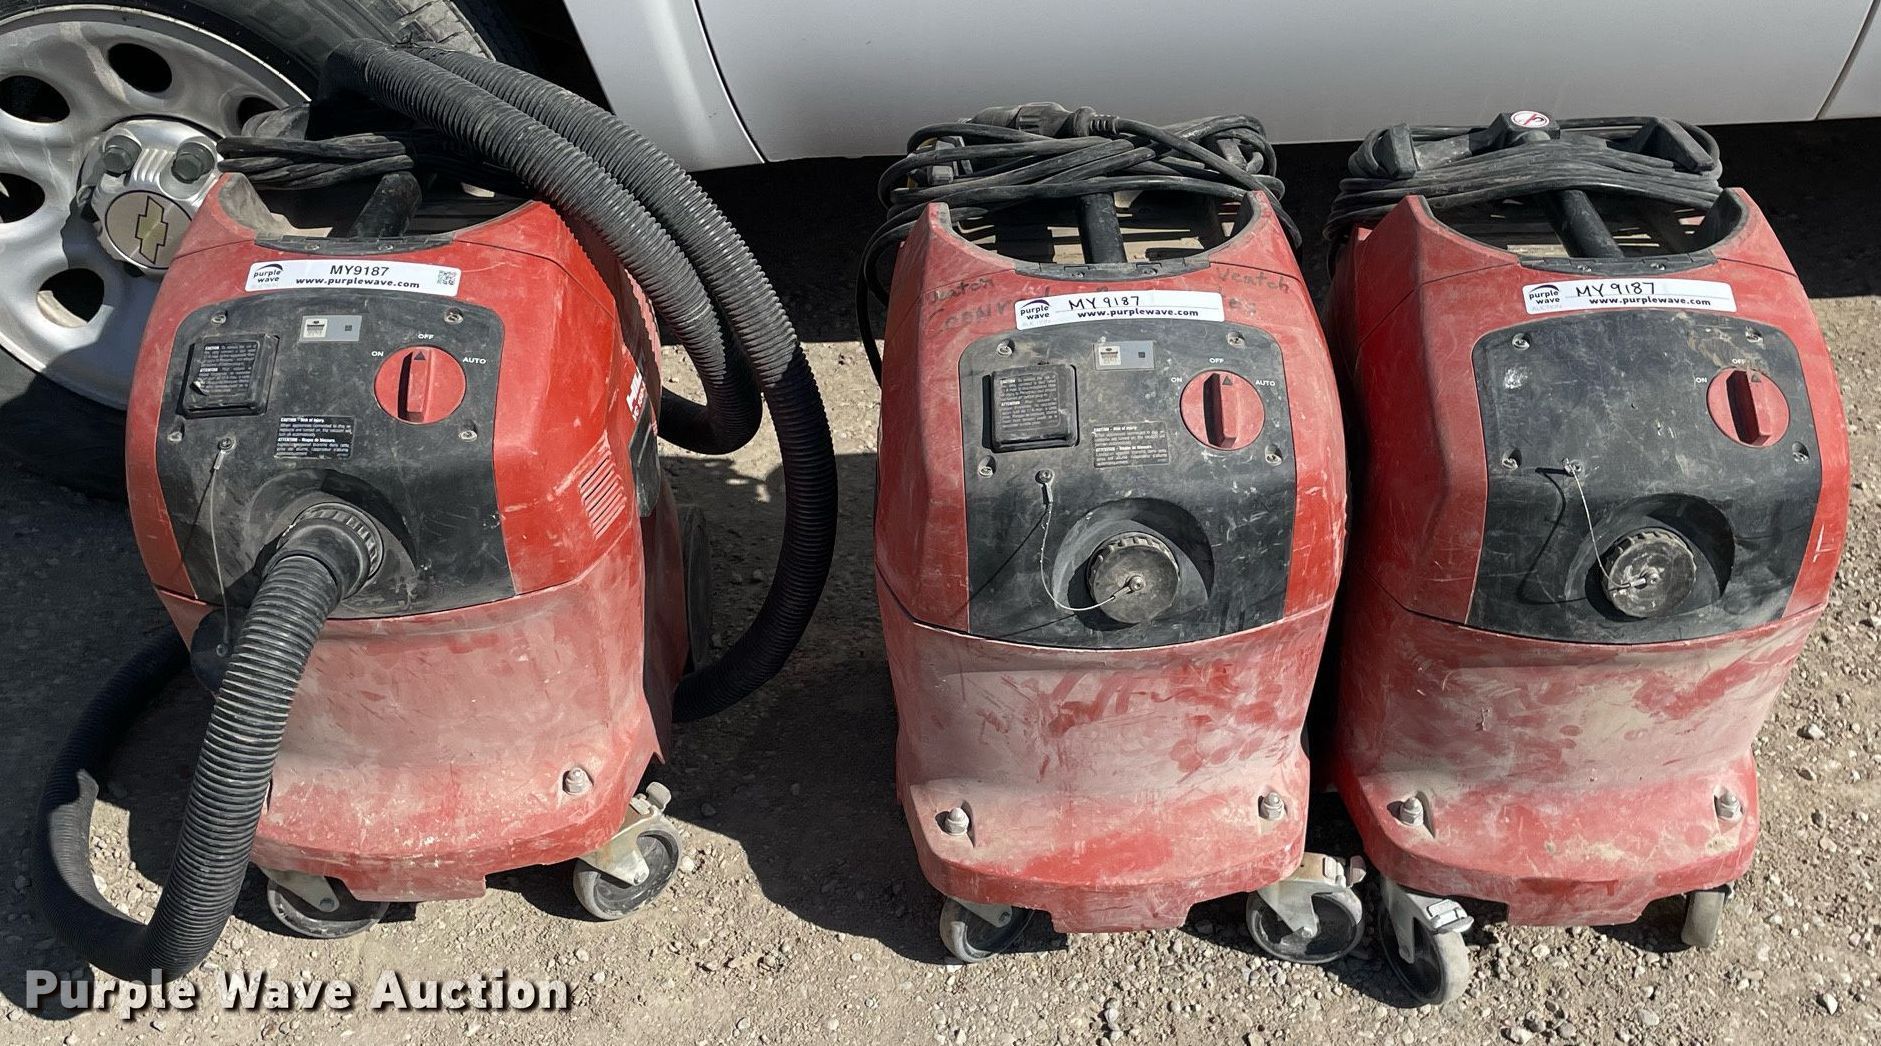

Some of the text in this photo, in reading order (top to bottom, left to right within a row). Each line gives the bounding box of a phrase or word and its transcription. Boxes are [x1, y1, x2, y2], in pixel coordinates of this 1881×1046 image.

[253, 268, 282, 278] purple
[329, 265, 390, 277] MY9187
[296, 277, 420, 289] www.purplewave.com
[1529, 290, 1559, 300] purple
[1536, 297, 1560, 305] wave
[1589, 296, 1711, 306] www.purplewave.com
[1020, 305, 1049, 316] purple
[1077, 308, 1199, 318] www.purplewave.com
[1026, 312, 1050, 320] wave
[462, 356, 487, 365] AUTO
[1255, 379, 1276, 387] AUTO
